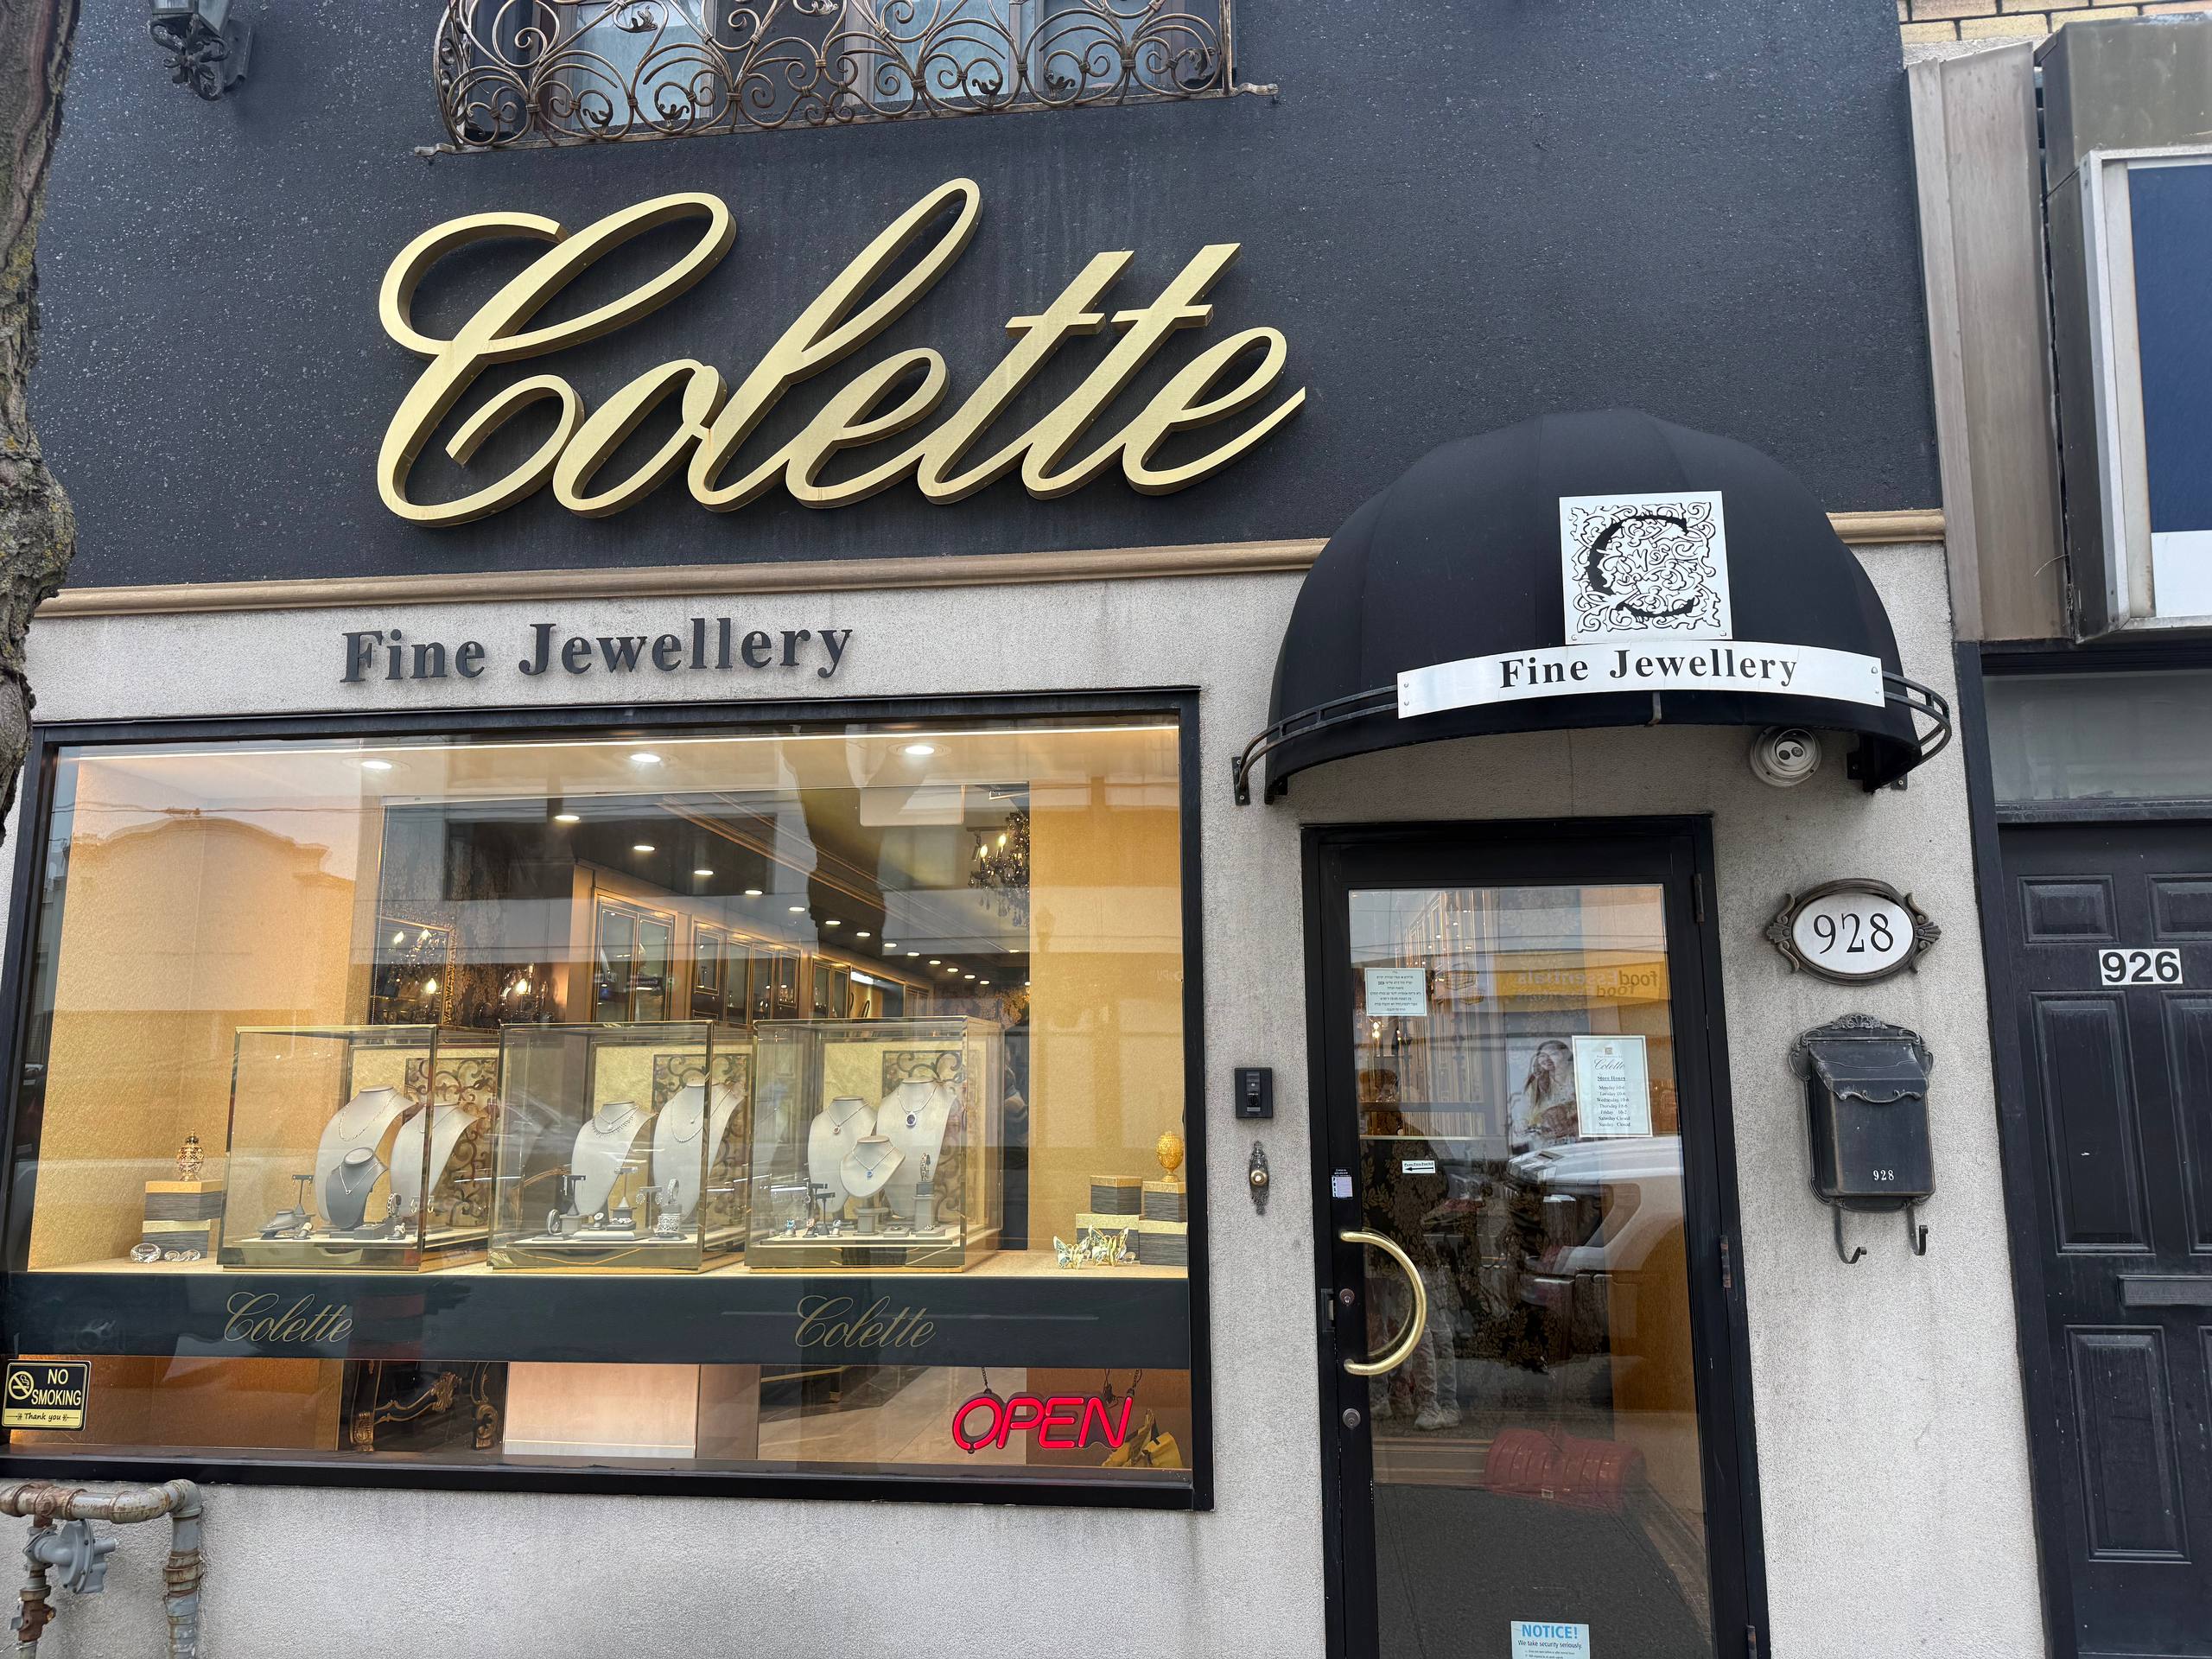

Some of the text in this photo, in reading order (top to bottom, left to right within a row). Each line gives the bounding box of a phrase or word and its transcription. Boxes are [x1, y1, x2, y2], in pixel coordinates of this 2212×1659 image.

[377, 177, 1306, 527] Colette
[340, 617, 854, 683] Fine Jewellery
[1499, 648, 1797, 689] Fine Jewellery
[1813, 912, 1894, 955] 928
[2101, 950, 2180, 982] 926
[1872, 1169, 1895, 1181] 928
[224, 1291, 354, 1343] Colette
[795, 1294, 937, 1348] Colette
[31, 1389, 82, 1406] SMOKING
[48, 1369, 69, 1385] NO
[952, 1396, 1133, 1451] OPEN
[1522, 1624, 1578, 1639] NOTICE!
